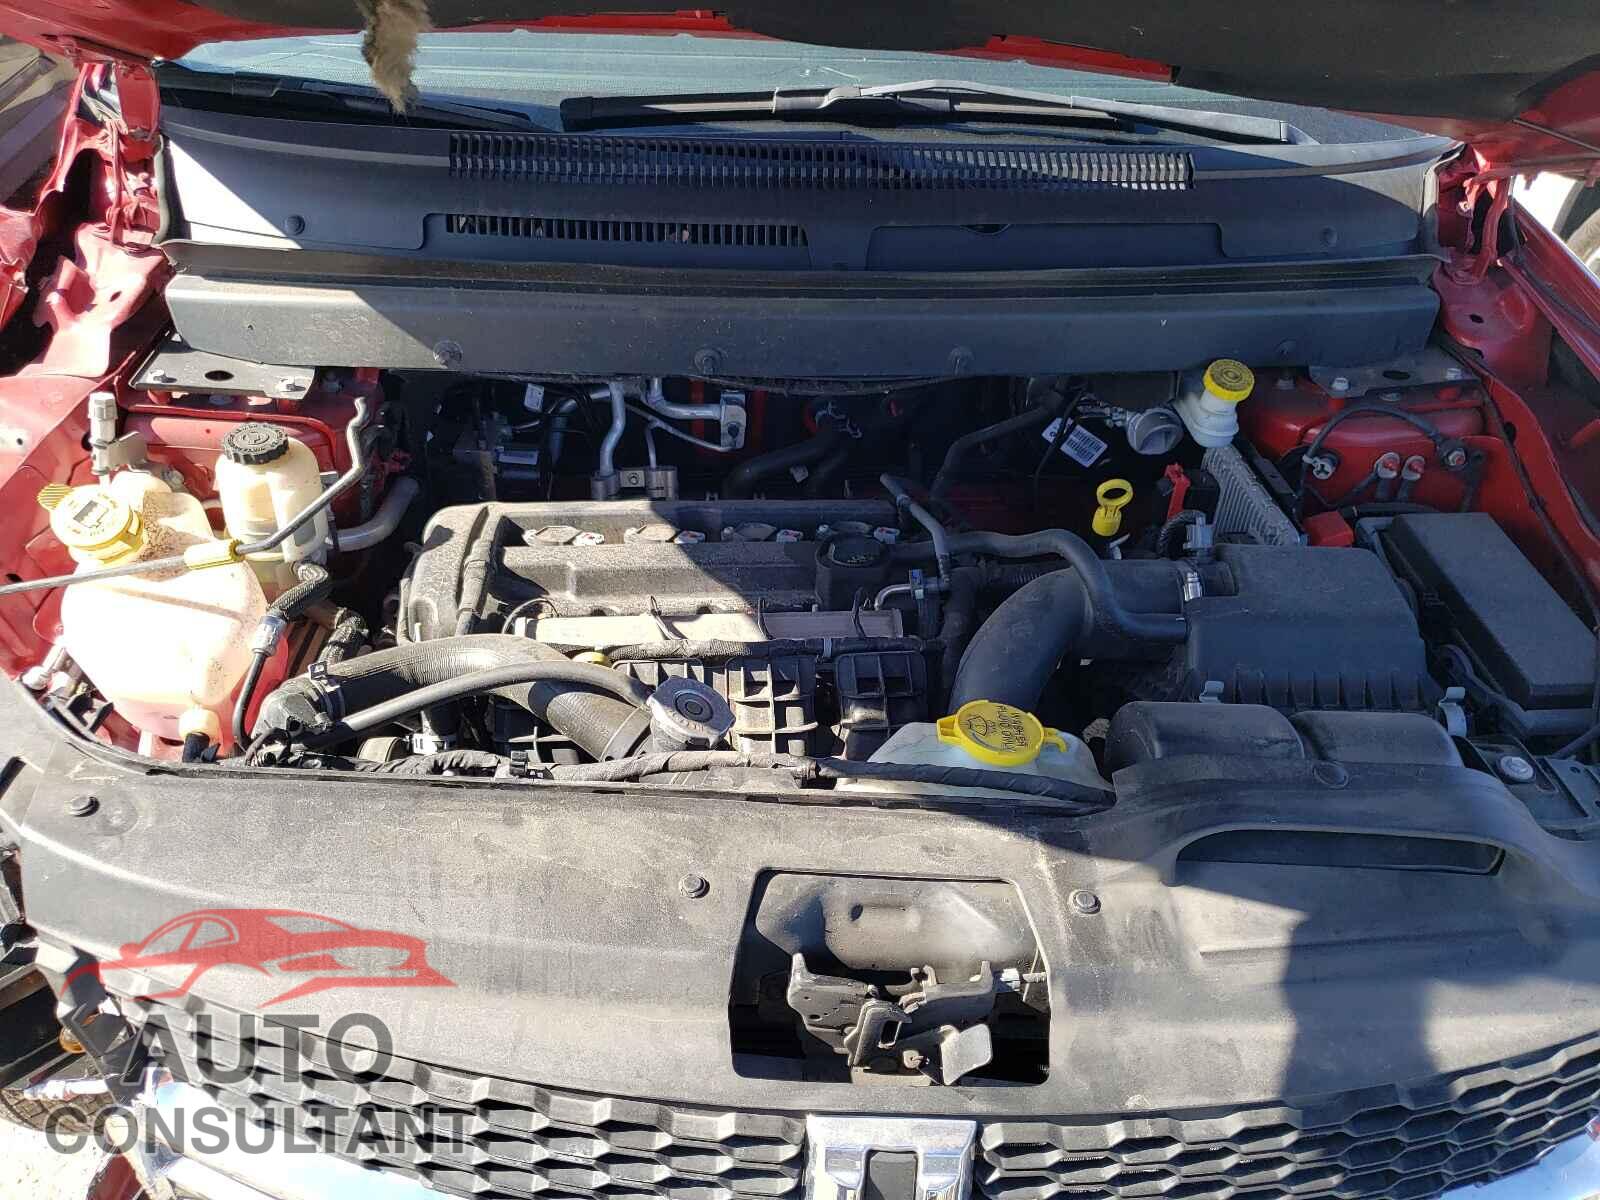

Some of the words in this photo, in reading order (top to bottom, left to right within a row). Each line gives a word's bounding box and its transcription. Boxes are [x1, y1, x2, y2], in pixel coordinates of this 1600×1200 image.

[995, 705, 1010, 729] FLUID
[1001, 729, 1017, 752] ONLY
[1009, 712, 1026, 747] WASHER
